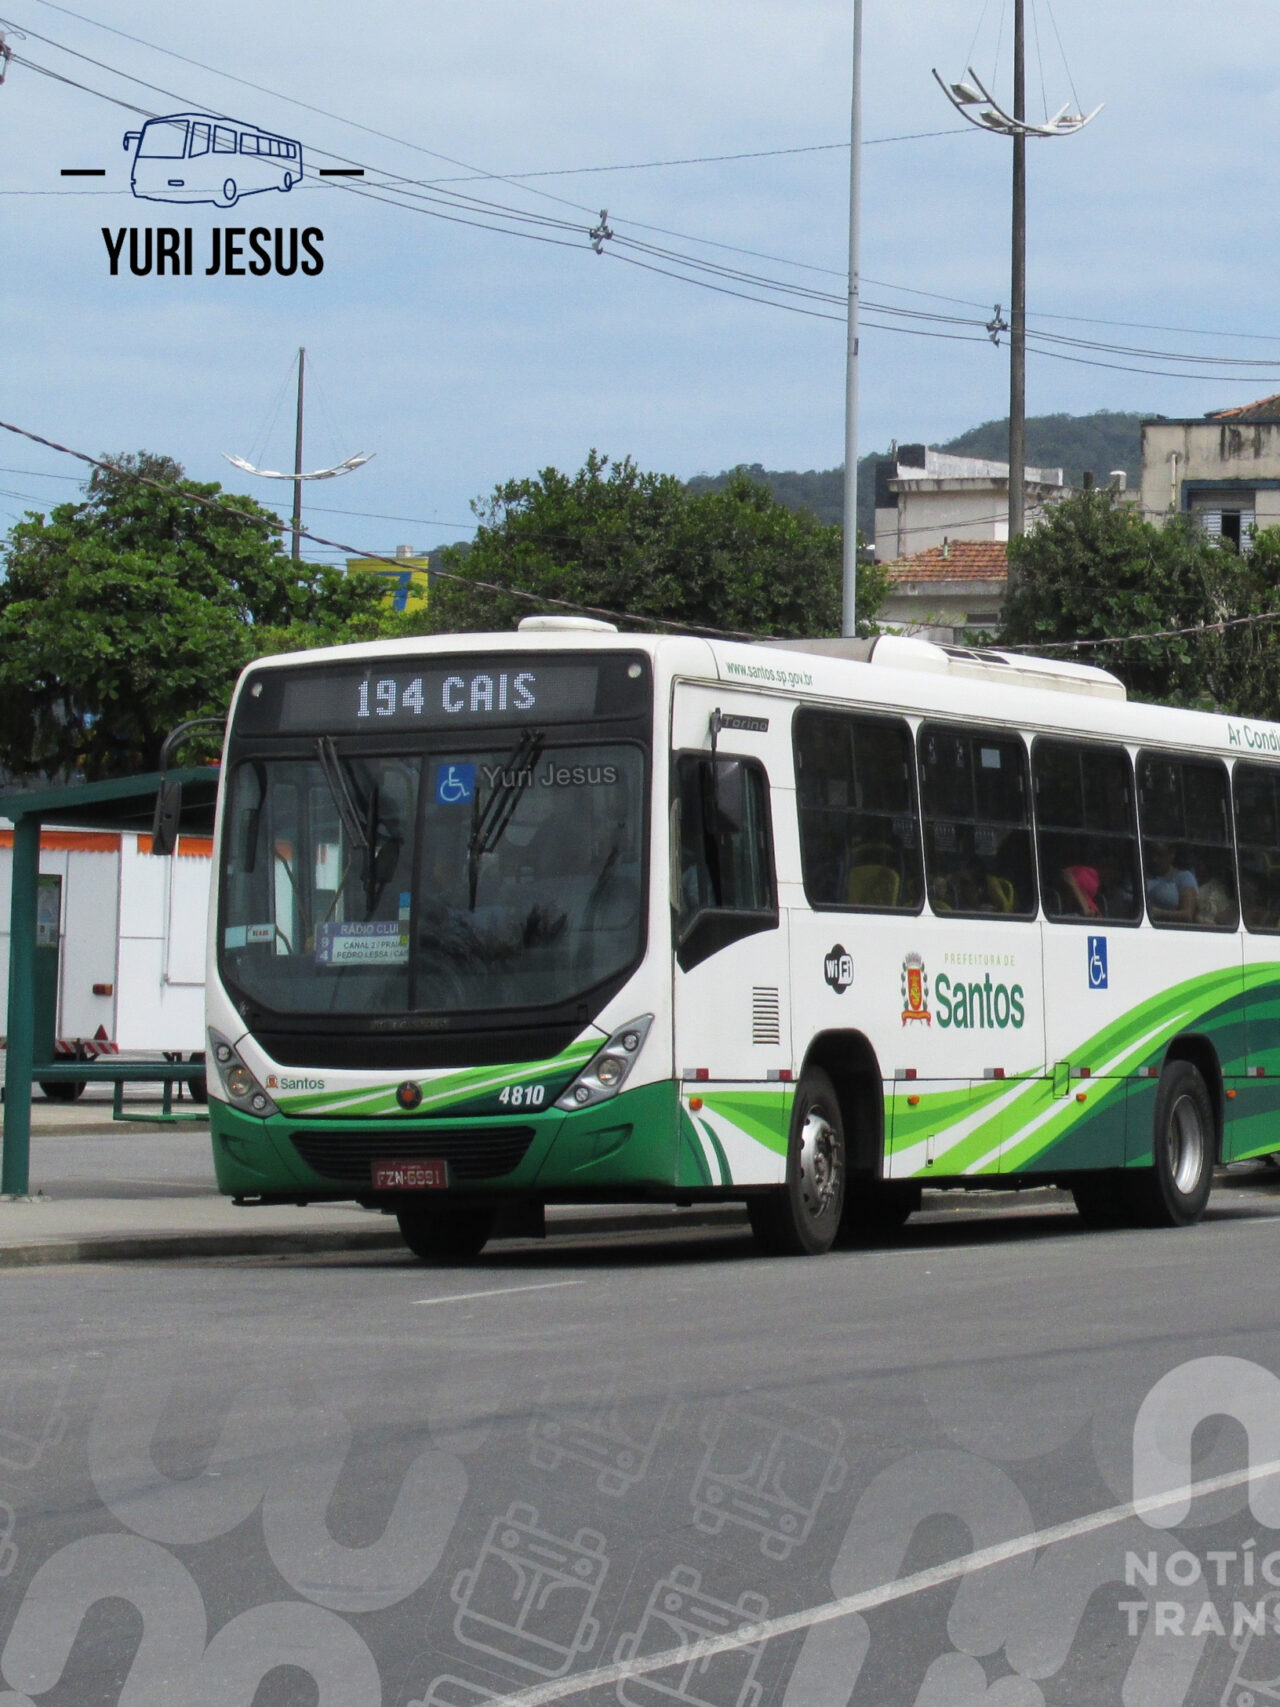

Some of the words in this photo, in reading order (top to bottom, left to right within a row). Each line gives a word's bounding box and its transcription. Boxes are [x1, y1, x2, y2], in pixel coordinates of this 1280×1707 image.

[726, 661, 814, 688] www.santos.sp.gov.br
[357, 679, 425, 717] 194
[442, 672, 536, 713] CAIS
[1228, 722, 1242, 745] Ar
[944, 952, 1001, 966] PREFEITURA
[1003, 954, 1015, 967] DE
[935, 972, 1025, 1029] Santos
[280, 1077, 325, 1091] Santos
[499, 1084, 545, 1106] 4810
